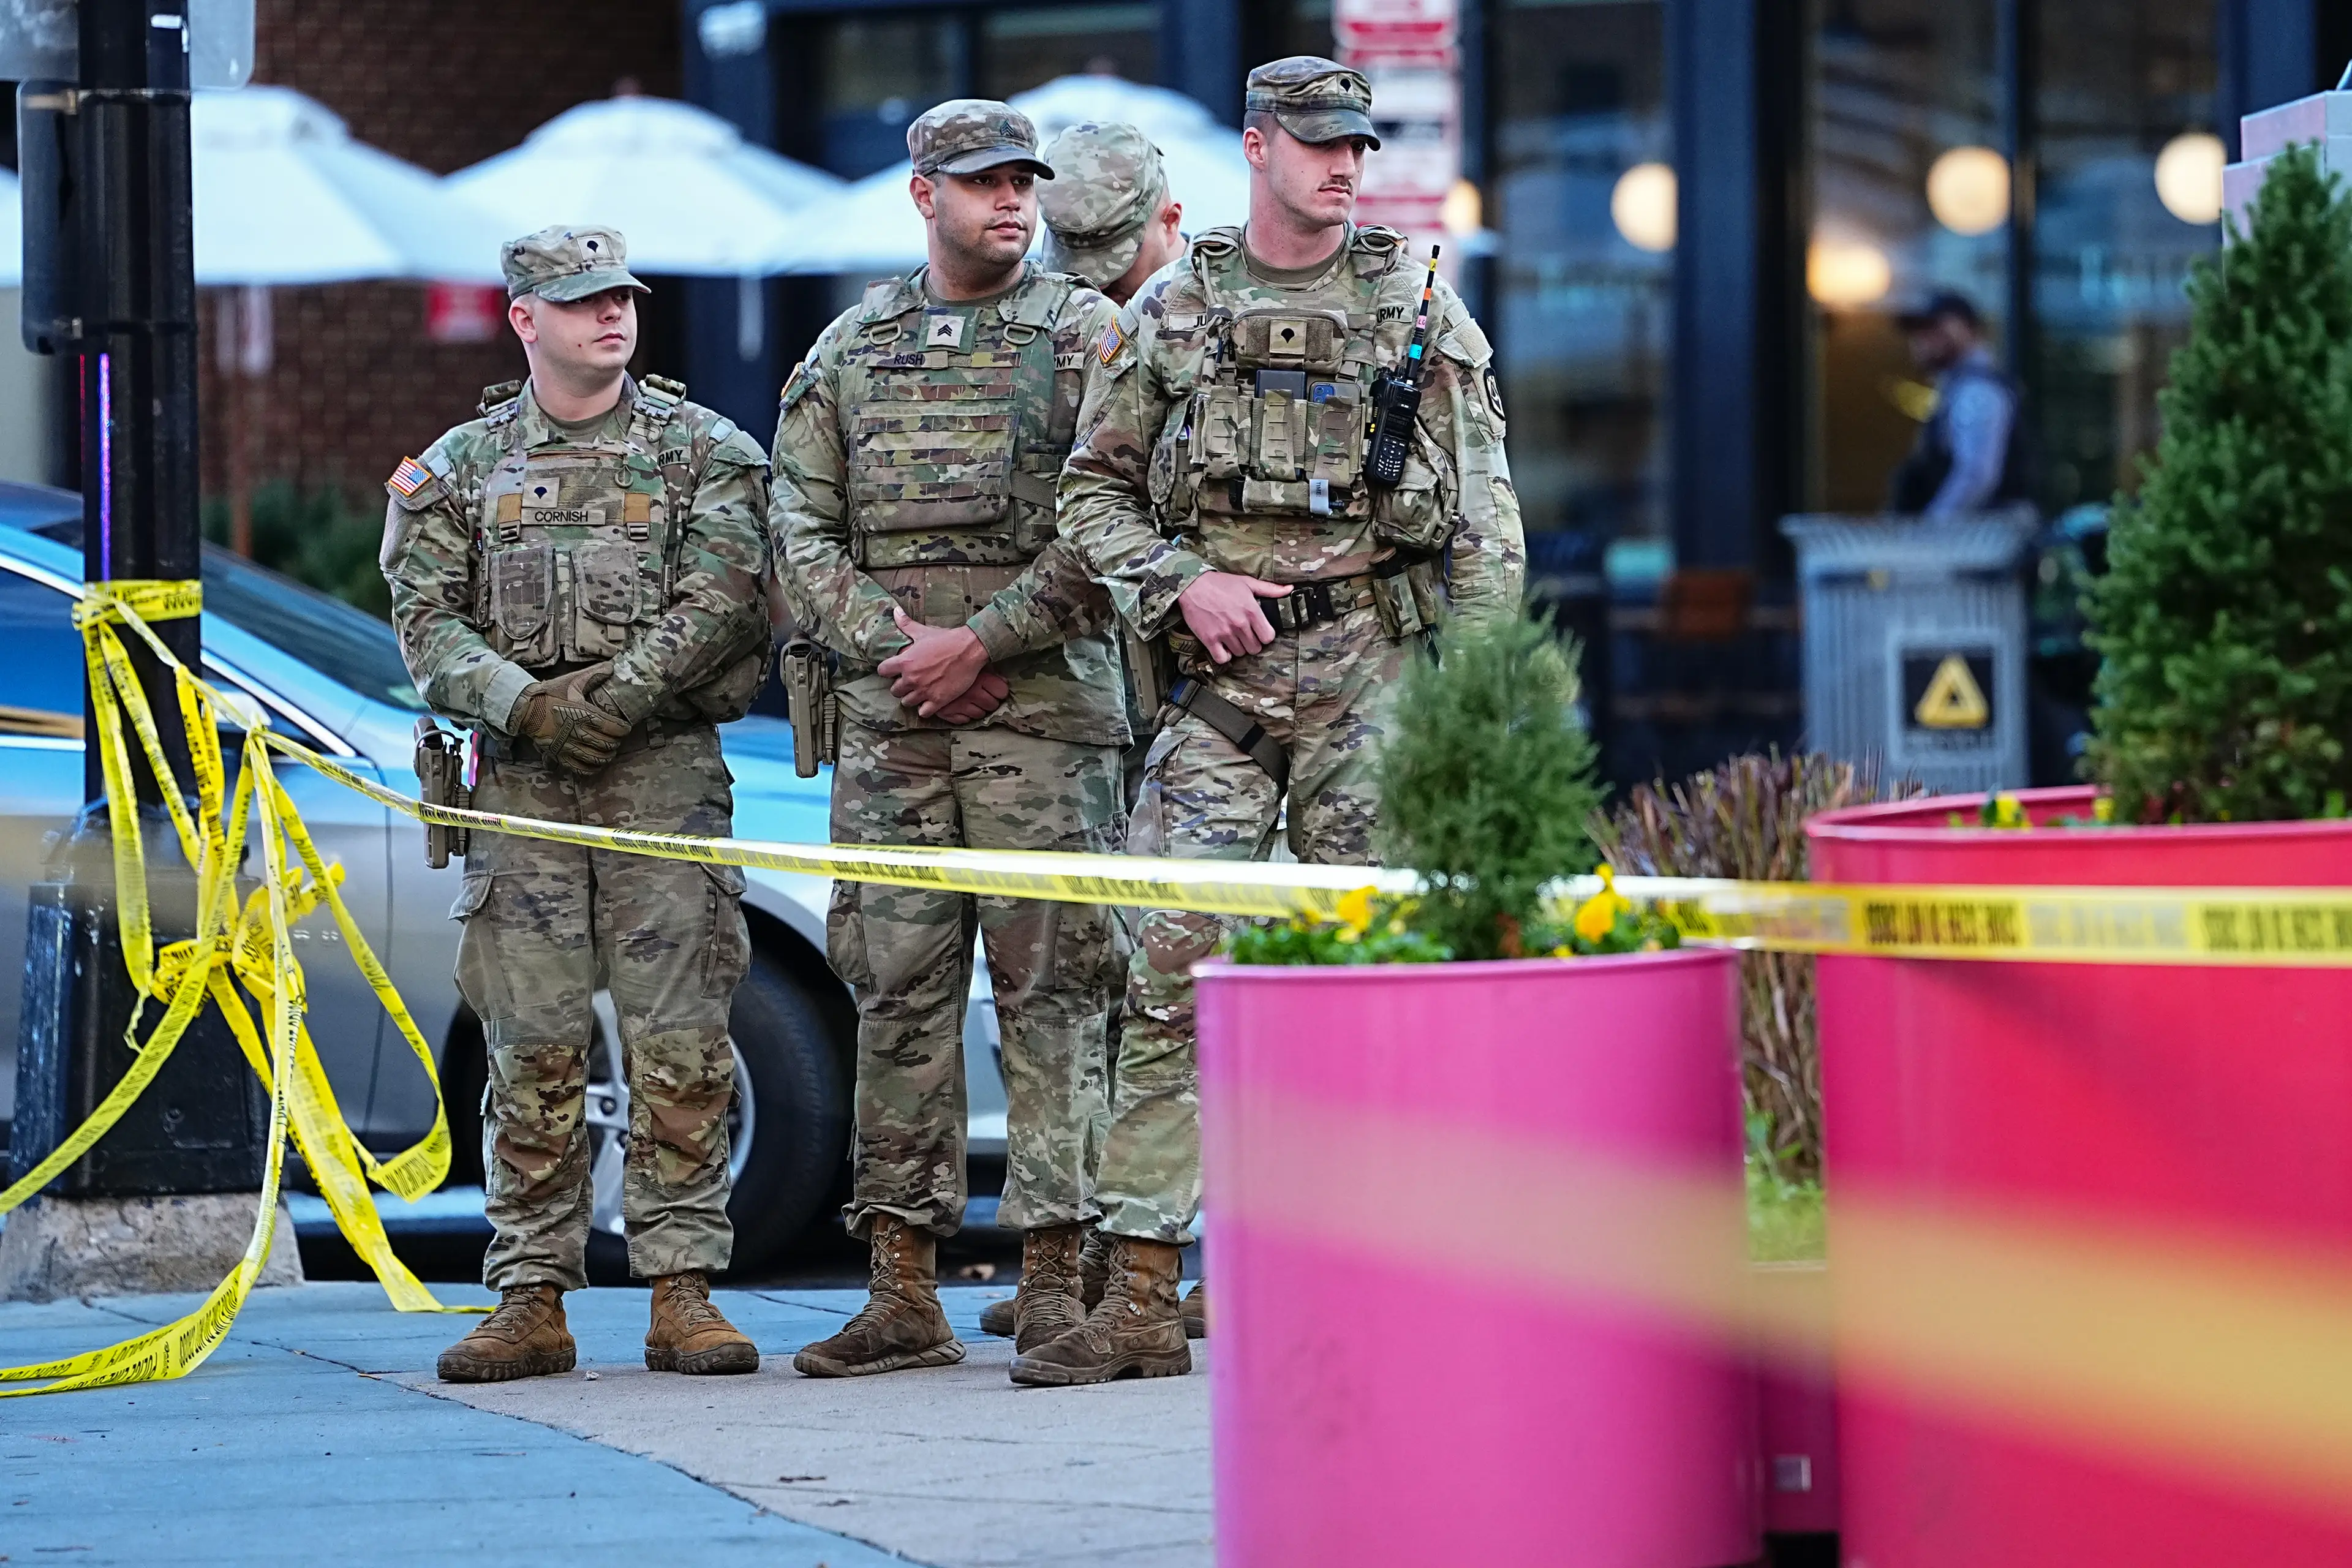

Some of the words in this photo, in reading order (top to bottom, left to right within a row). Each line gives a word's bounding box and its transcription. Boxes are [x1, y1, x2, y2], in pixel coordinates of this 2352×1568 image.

[894, 353, 923, 365] RUSH
[658, 450, 684, 467] RMY
[535, 510, 588, 522] CORNISH
